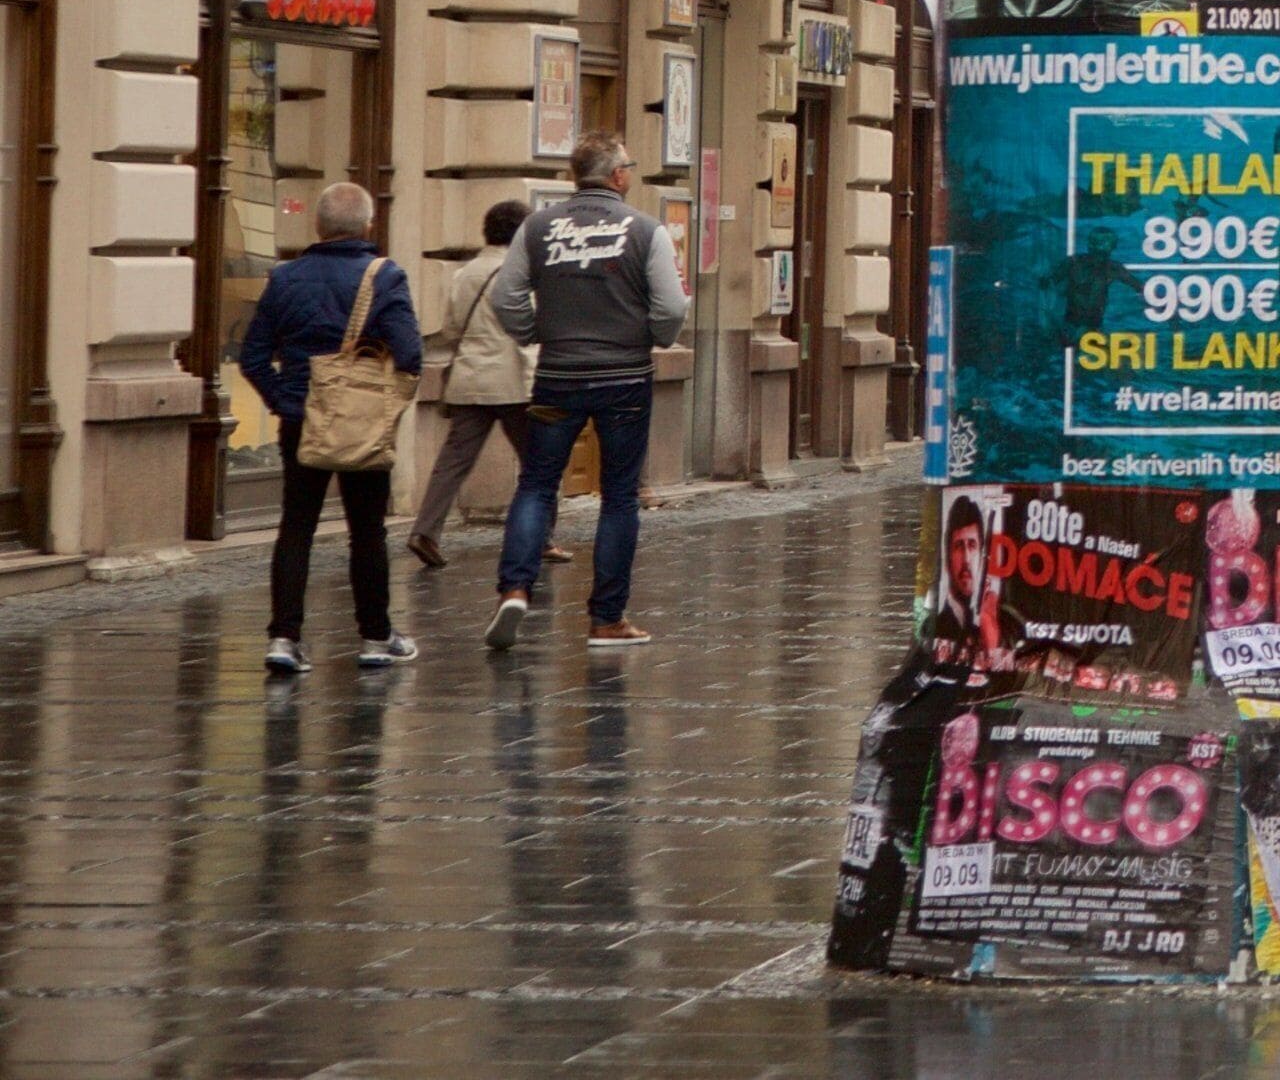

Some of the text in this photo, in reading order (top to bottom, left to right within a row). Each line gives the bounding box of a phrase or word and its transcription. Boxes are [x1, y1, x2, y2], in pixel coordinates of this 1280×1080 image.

[1142, 215, 1280, 260] 890€
[1143, 274, 1280, 323] 990€
[1078, 331, 1156, 371] SRI
[1062, 453, 1106, 477] bez
[1111, 452, 1222, 477] skrivenih
[986, 532, 1194, 620] DOMAĆE
[1023, 726, 1100, 744] STUDENATA
[1106, 729, 1163, 747] TEHNIKE
[1190, 743, 1218, 759] KST
[1102, 929, 1132, 952] DJ
